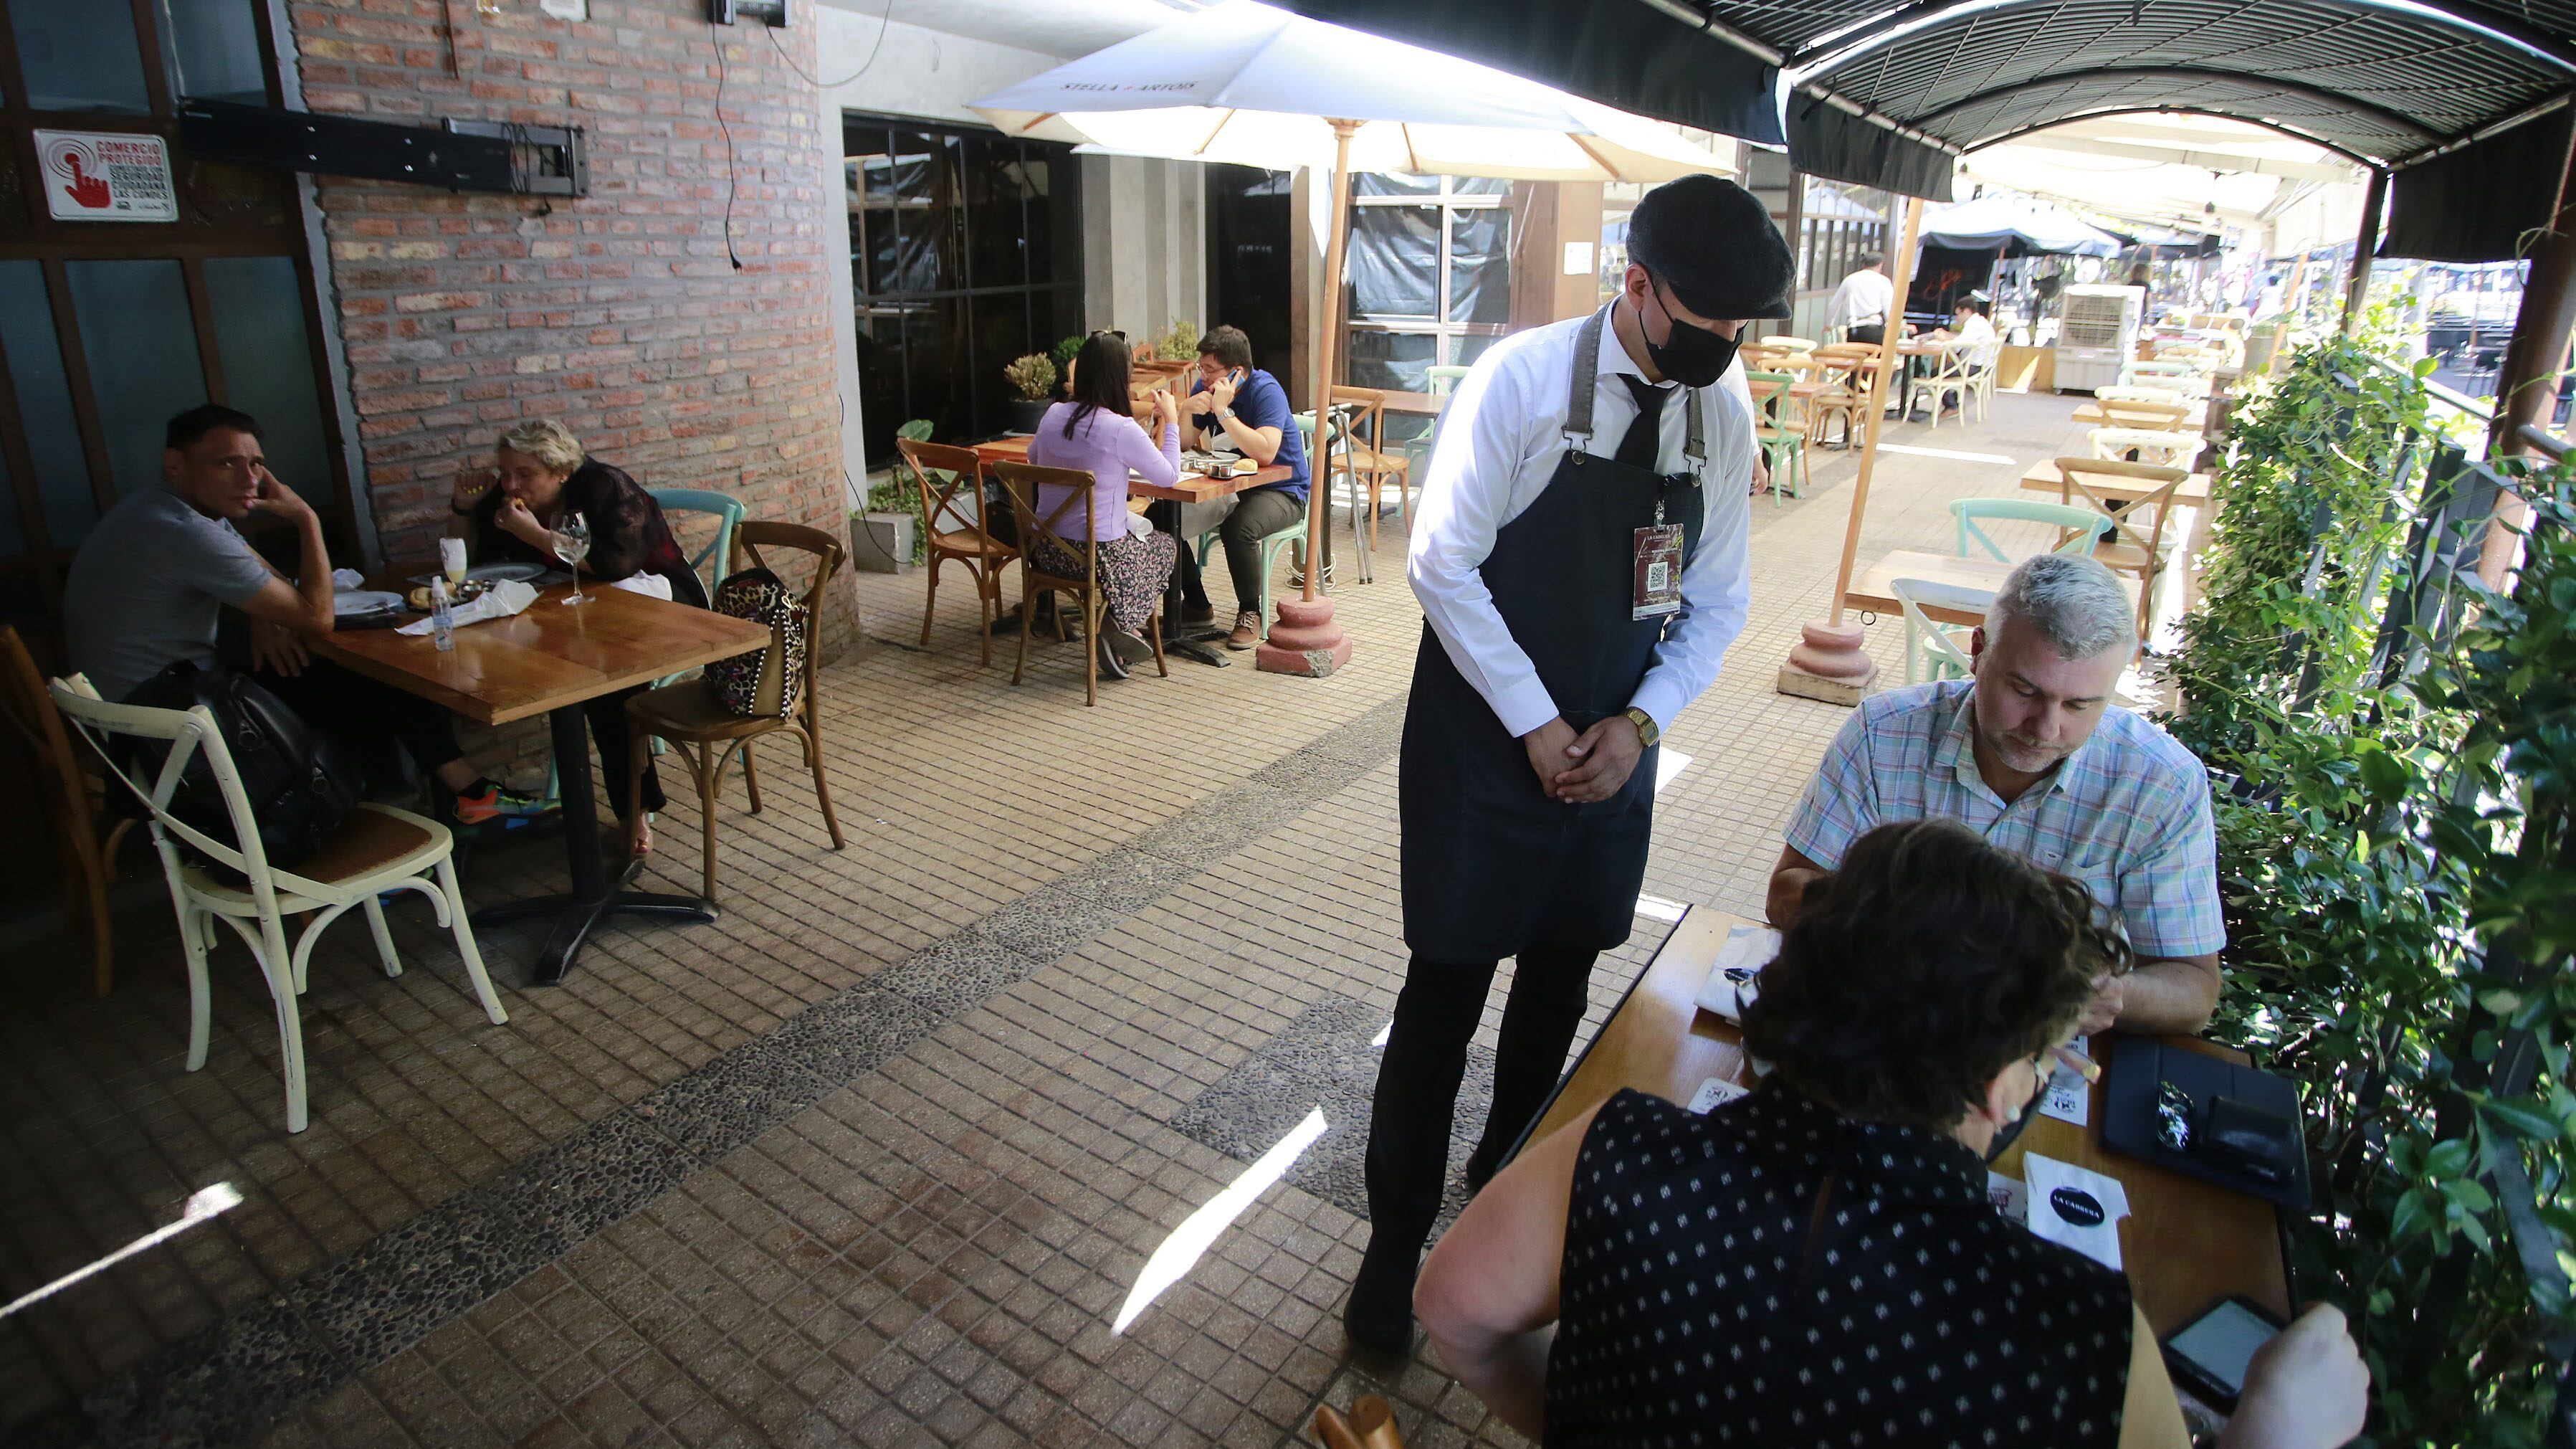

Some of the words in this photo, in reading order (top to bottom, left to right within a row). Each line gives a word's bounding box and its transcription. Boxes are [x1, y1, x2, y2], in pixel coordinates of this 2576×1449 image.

[1061, 82, 1120, 91] STELLA
[1139, 81, 1199, 90] ARTOIS
[97, 141, 160, 154] COMERCIO
[99, 153, 161, 166] PROTEGIDO
[2054, 1194, 2064, 1205] LA
